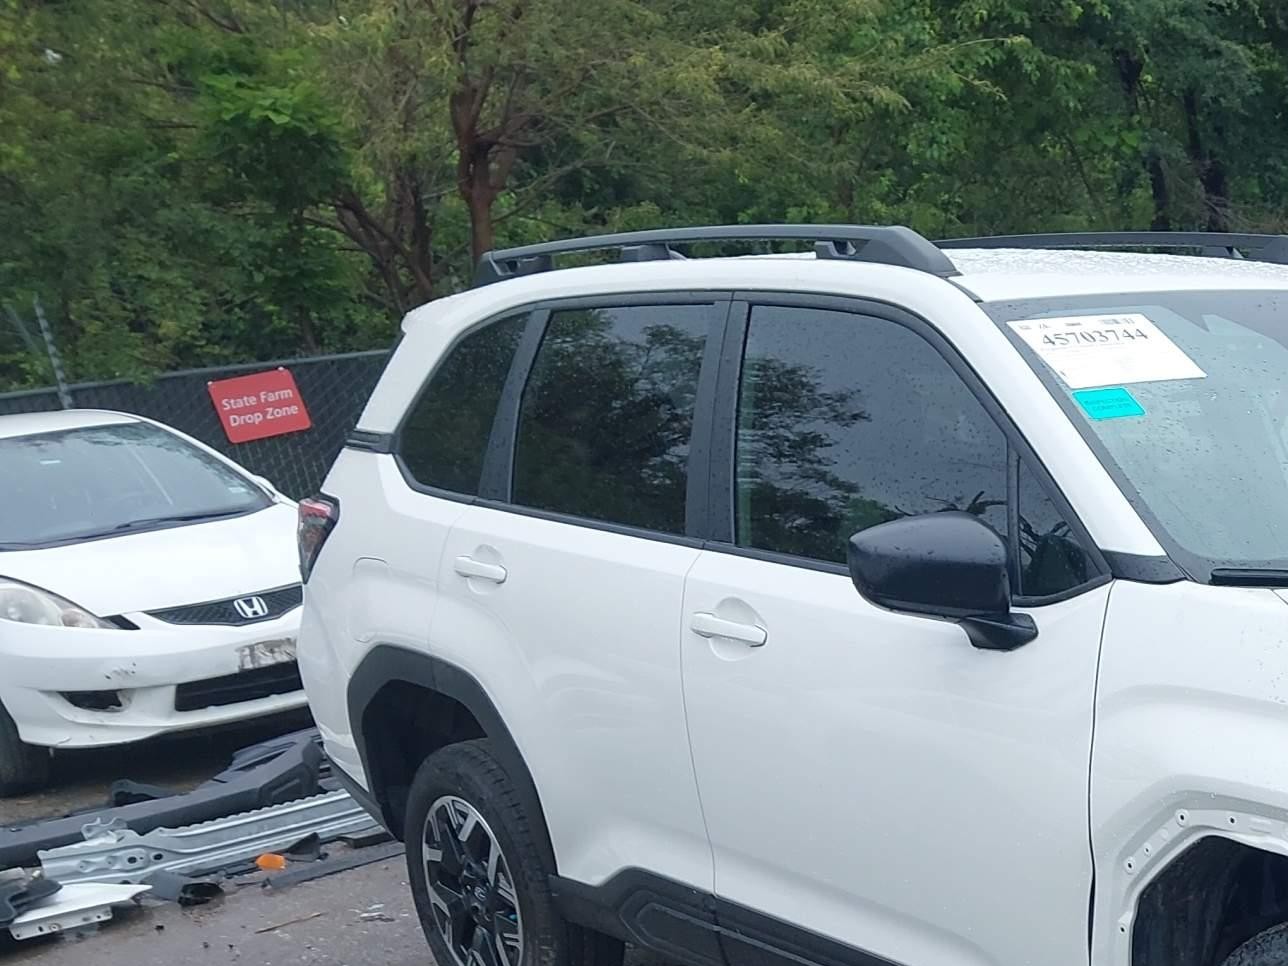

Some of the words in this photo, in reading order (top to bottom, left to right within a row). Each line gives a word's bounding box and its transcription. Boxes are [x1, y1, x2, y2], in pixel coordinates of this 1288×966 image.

[1042, 329, 1148, 346] 45703744
[222, 396, 257, 410] State
[260, 389, 293, 403] Farm
[229, 412, 263, 426] Drop
[266, 405, 299, 419] Zone
